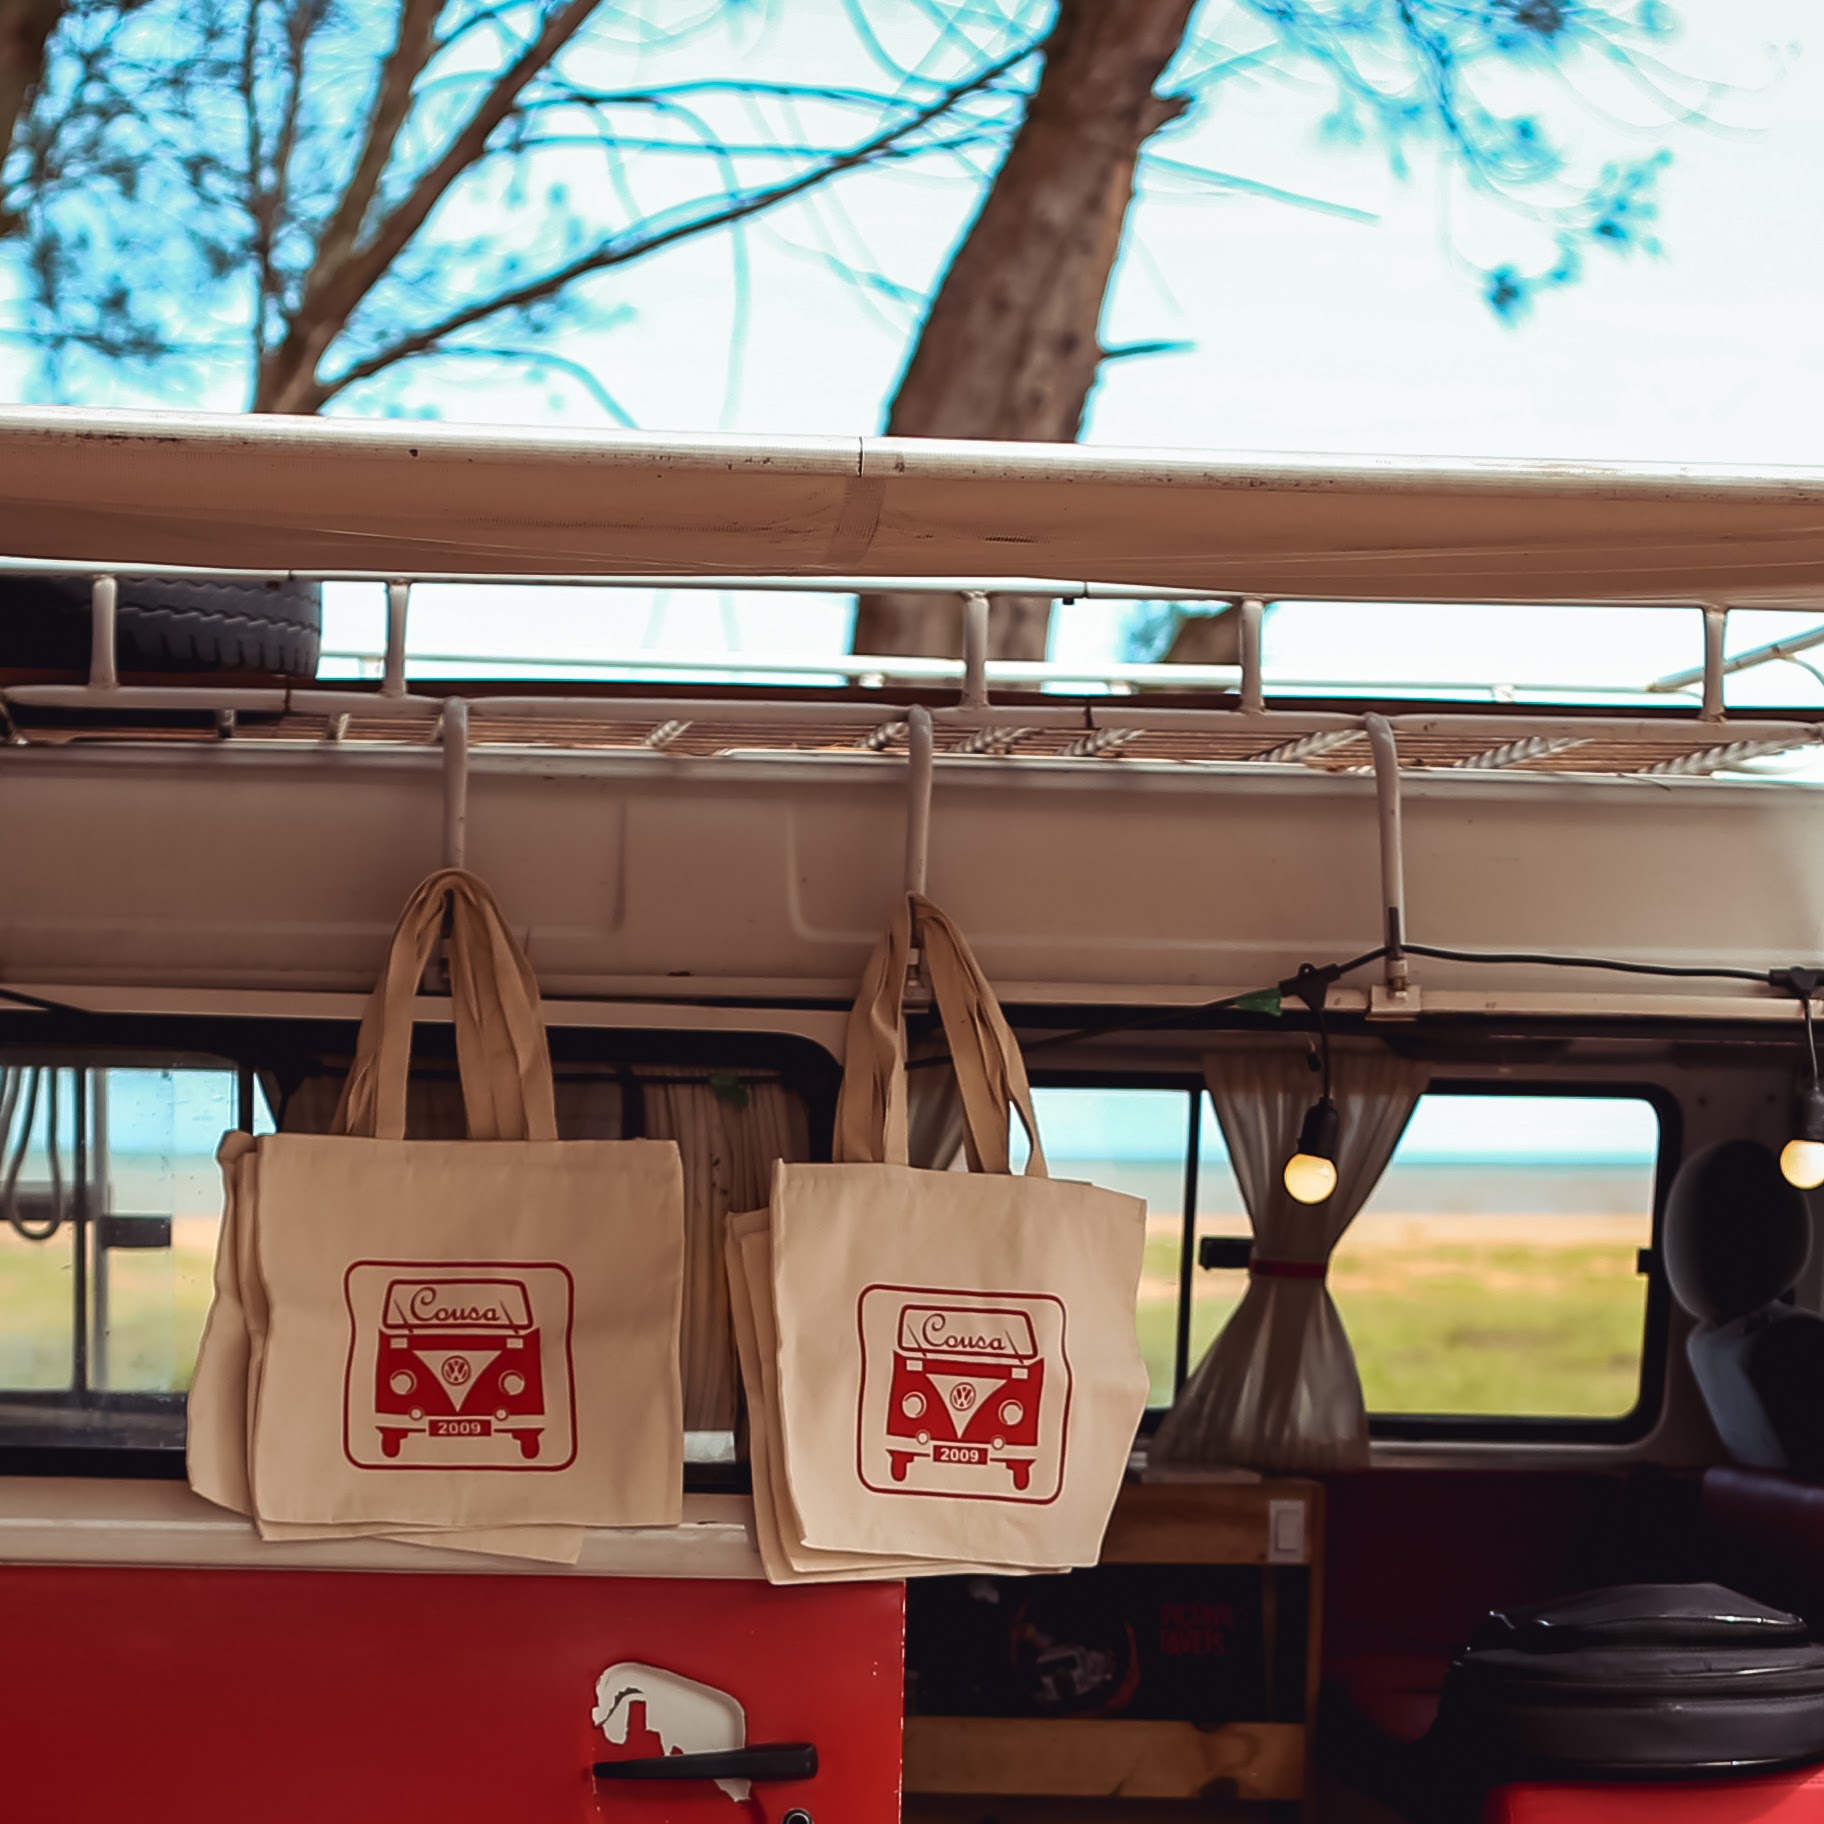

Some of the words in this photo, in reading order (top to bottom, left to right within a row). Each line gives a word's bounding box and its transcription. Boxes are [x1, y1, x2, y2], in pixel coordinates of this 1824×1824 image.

[410, 1286, 500, 1322] Cousa
[922, 1313, 1007, 1351] Cousa
[437, 1421, 481, 1435] 2009
[939, 1447, 979, 1462] 2009
